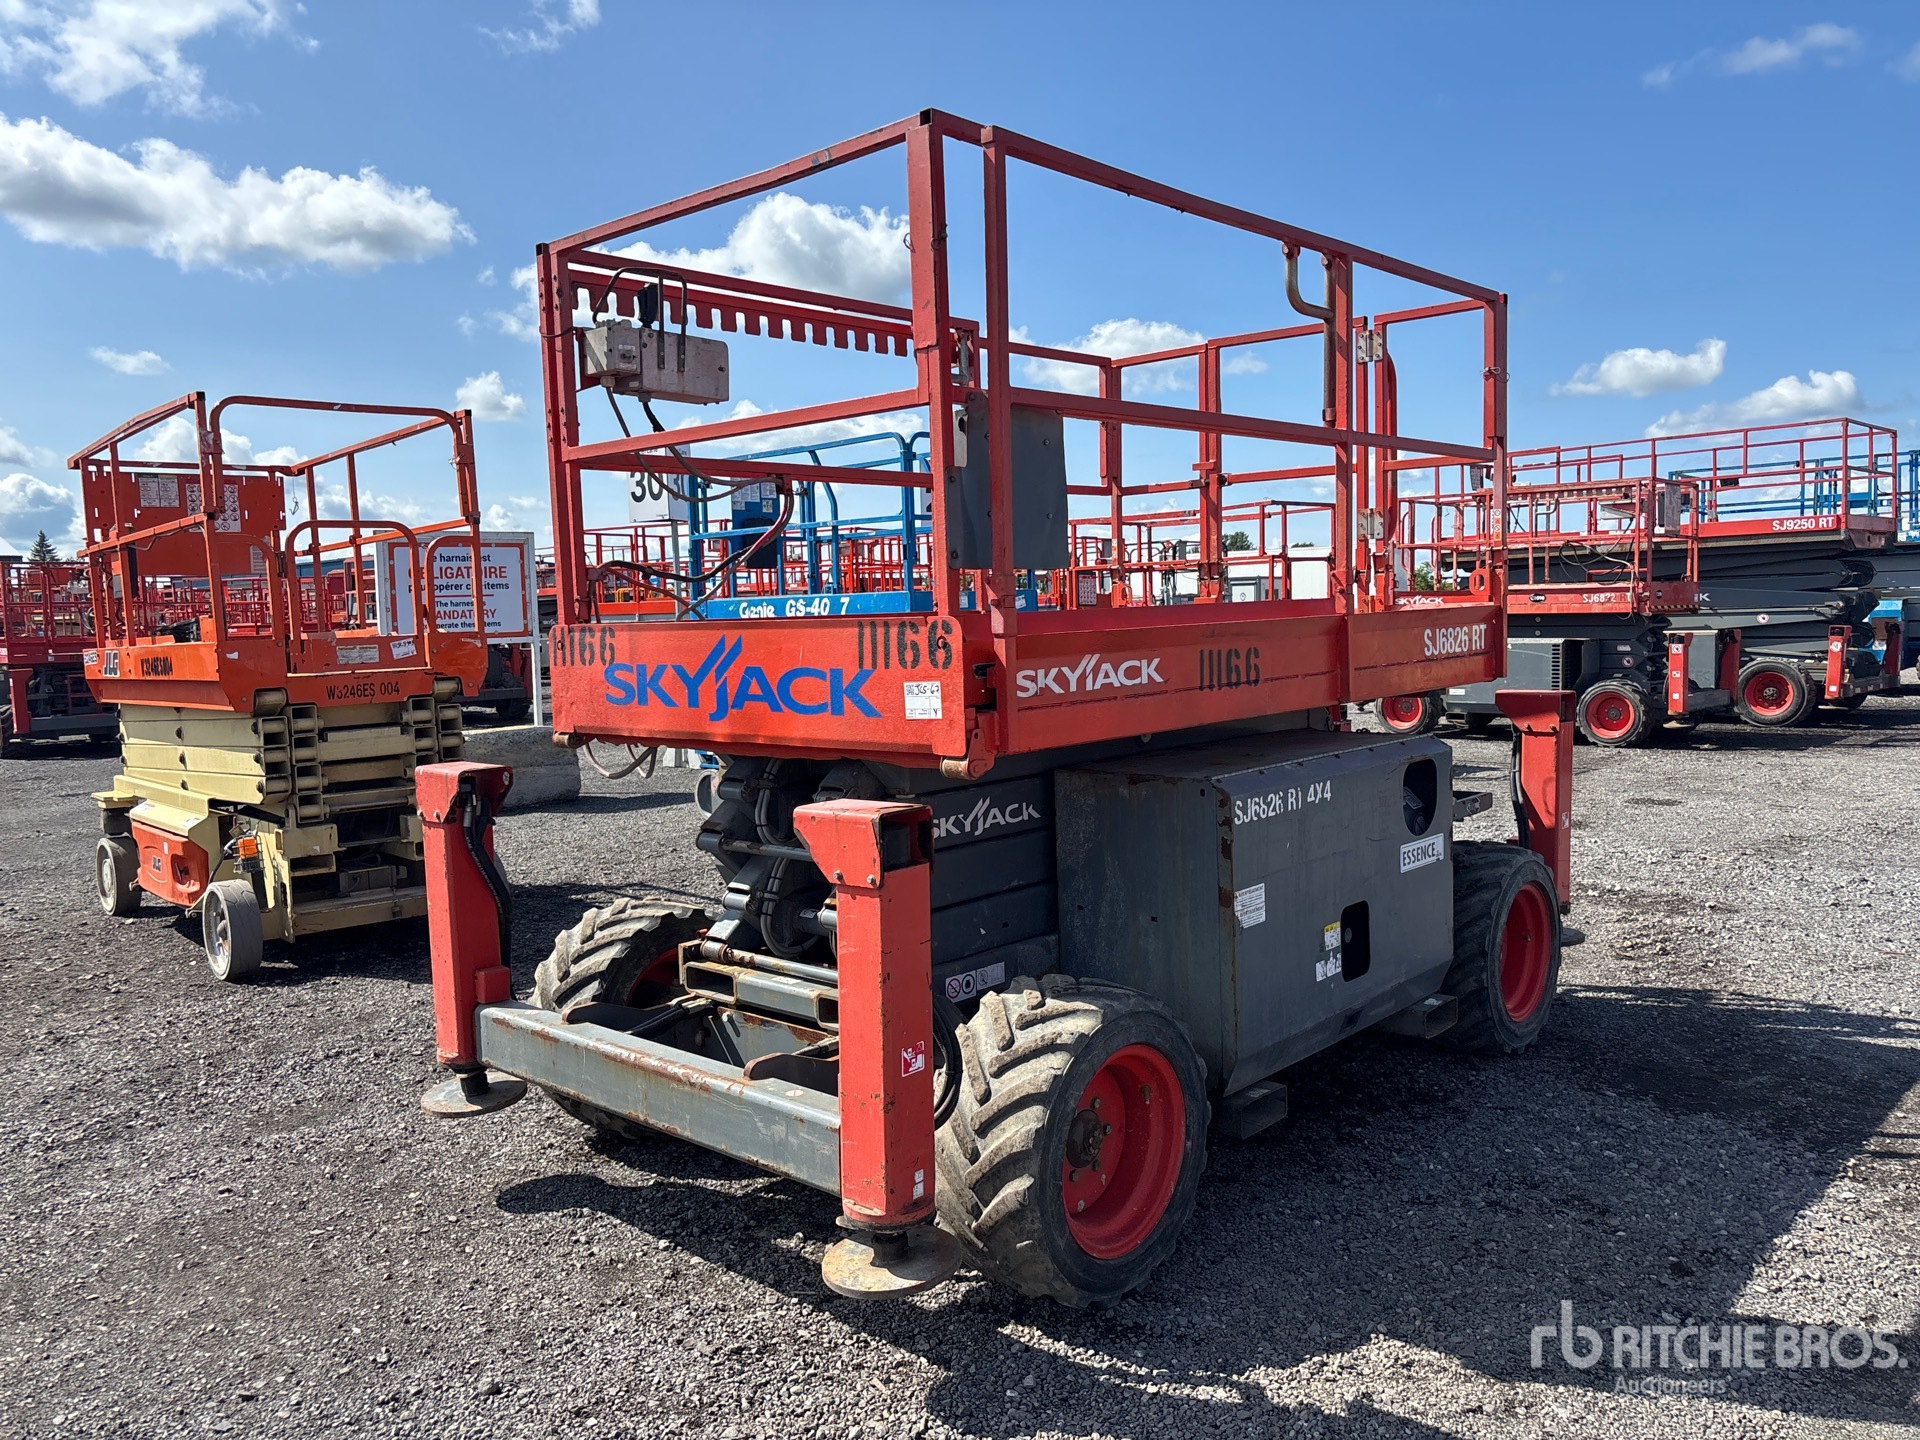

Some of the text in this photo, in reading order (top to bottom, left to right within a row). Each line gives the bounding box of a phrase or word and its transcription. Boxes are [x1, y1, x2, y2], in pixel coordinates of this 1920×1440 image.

[1772, 516, 1834, 531] SJ9250 RT
[484, 581, 509, 590] items
[436, 609, 496, 620] ANDATRY
[857, 620, 953, 669] 11166
[1424, 624, 1488, 657] SJ6826 RT
[104, 651, 119, 676] JLG
[604, 634, 884, 722] SKYJACK
[1016, 654, 1164, 697] SKYJACK
[1200, 647, 1261, 691] 11166
[380, 681, 401, 695] 004
[1234, 791, 1284, 825] SJ6826
[1307, 780, 1332, 804] 4X4
[1402, 842, 1436, 867] ESSENCE
